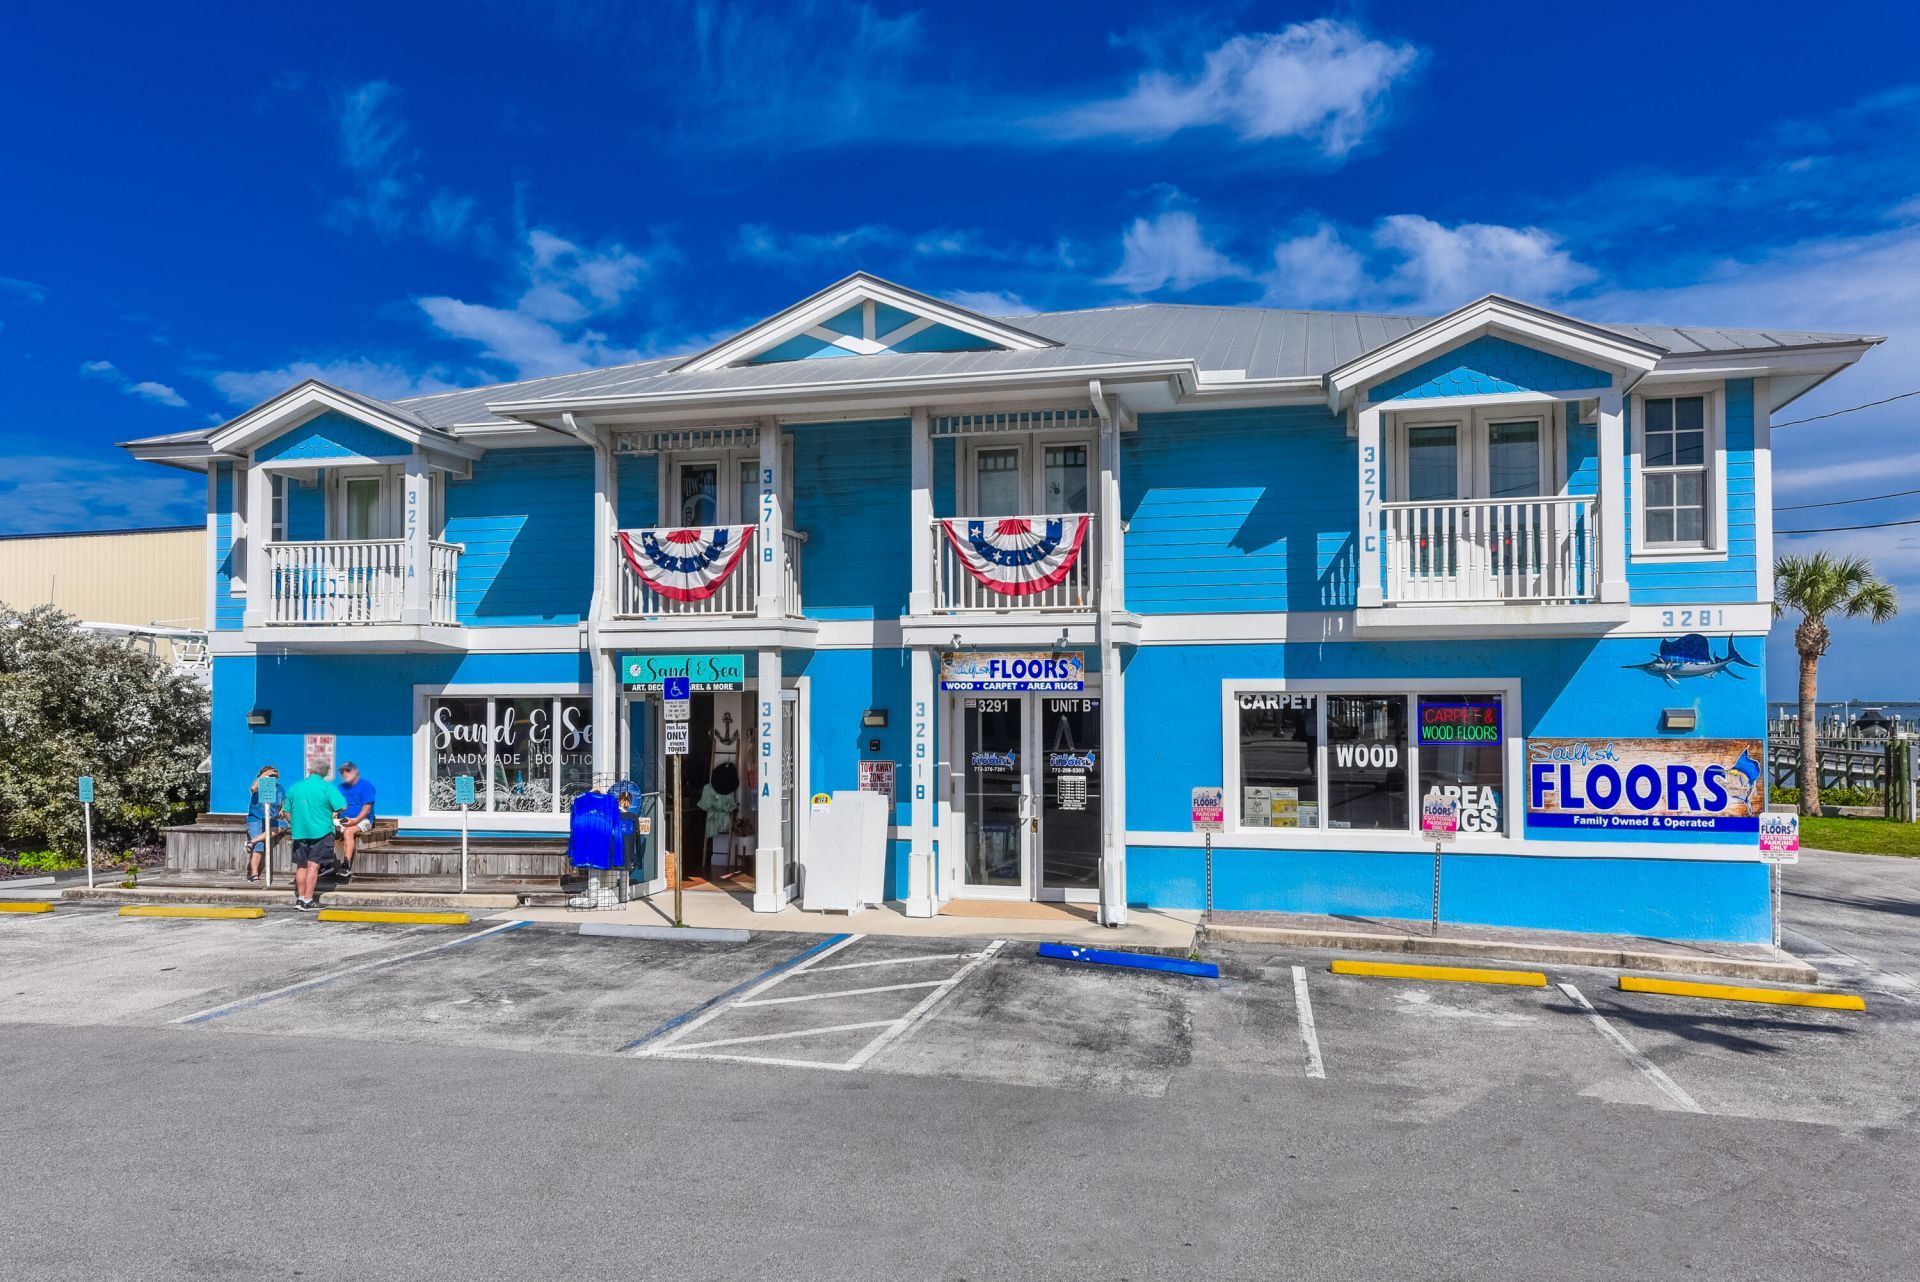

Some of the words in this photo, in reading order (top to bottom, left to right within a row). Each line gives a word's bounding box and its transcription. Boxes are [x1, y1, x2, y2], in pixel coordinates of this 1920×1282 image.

[1364, 446, 1375, 552] 3271C
[763, 469, 773, 562] 3271B
[407, 491, 416, 577] 3271A
[1662, 610, 1723, 627] 3281
[646, 657, 692, 682] Sand
[708, 657, 740, 682] Sea
[990, 659, 1069, 679] FLOORS
[632, 684, 647, 692] ART,
[946, 682, 974, 690] WOOD
[983, 682, 1018, 690] CARPET
[1027, 682, 1052, 690] AREA
[1054, 682, 1079, 690] RUGS
[978, 699, 1008, 713] 3291
[1051, 699, 1080, 713] UNIT
[1082, 699, 1092, 713] B
[1239, 694, 1316, 710] CARPET
[1425, 708, 1479, 724] CARPET
[1484, 708, 1494, 723] &
[433, 706, 517, 749] Sand
[529, 708, 550, 744] &
[562, 706, 593, 750] Se
[666, 731, 687, 740] ONLY
[1422, 725, 1454, 740] WOOD
[1457, 725, 1498, 741] FLOORS
[762, 702, 771, 797] 3291A
[916, 702, 925, 800] 3291B
[1336, 743, 1398, 768] WOOD
[1529, 742, 1620, 766] Sailfish
[438, 753, 521, 765] HANDMADE
[535, 753, 593, 765] BOUTIQ
[861, 763, 873, 773] TOW
[876, 763, 892, 773] AWAY
[869, 773, 885, 782] ZONE
[1530, 762, 1728, 812] FLOORS
[1193, 798, 1218, 807] FLOORS
[1424, 806, 1451, 815] FLOORS
[1423, 815, 1456, 823] CUSTOMER
[1573, 815, 1608, 827] Family
[1611, 816, 1649, 827] Owned
[1652, 817, 1661, 827] &
[1664, 817, 1715, 829] Operated
[1761, 825, 1791, 834] FLOORS
